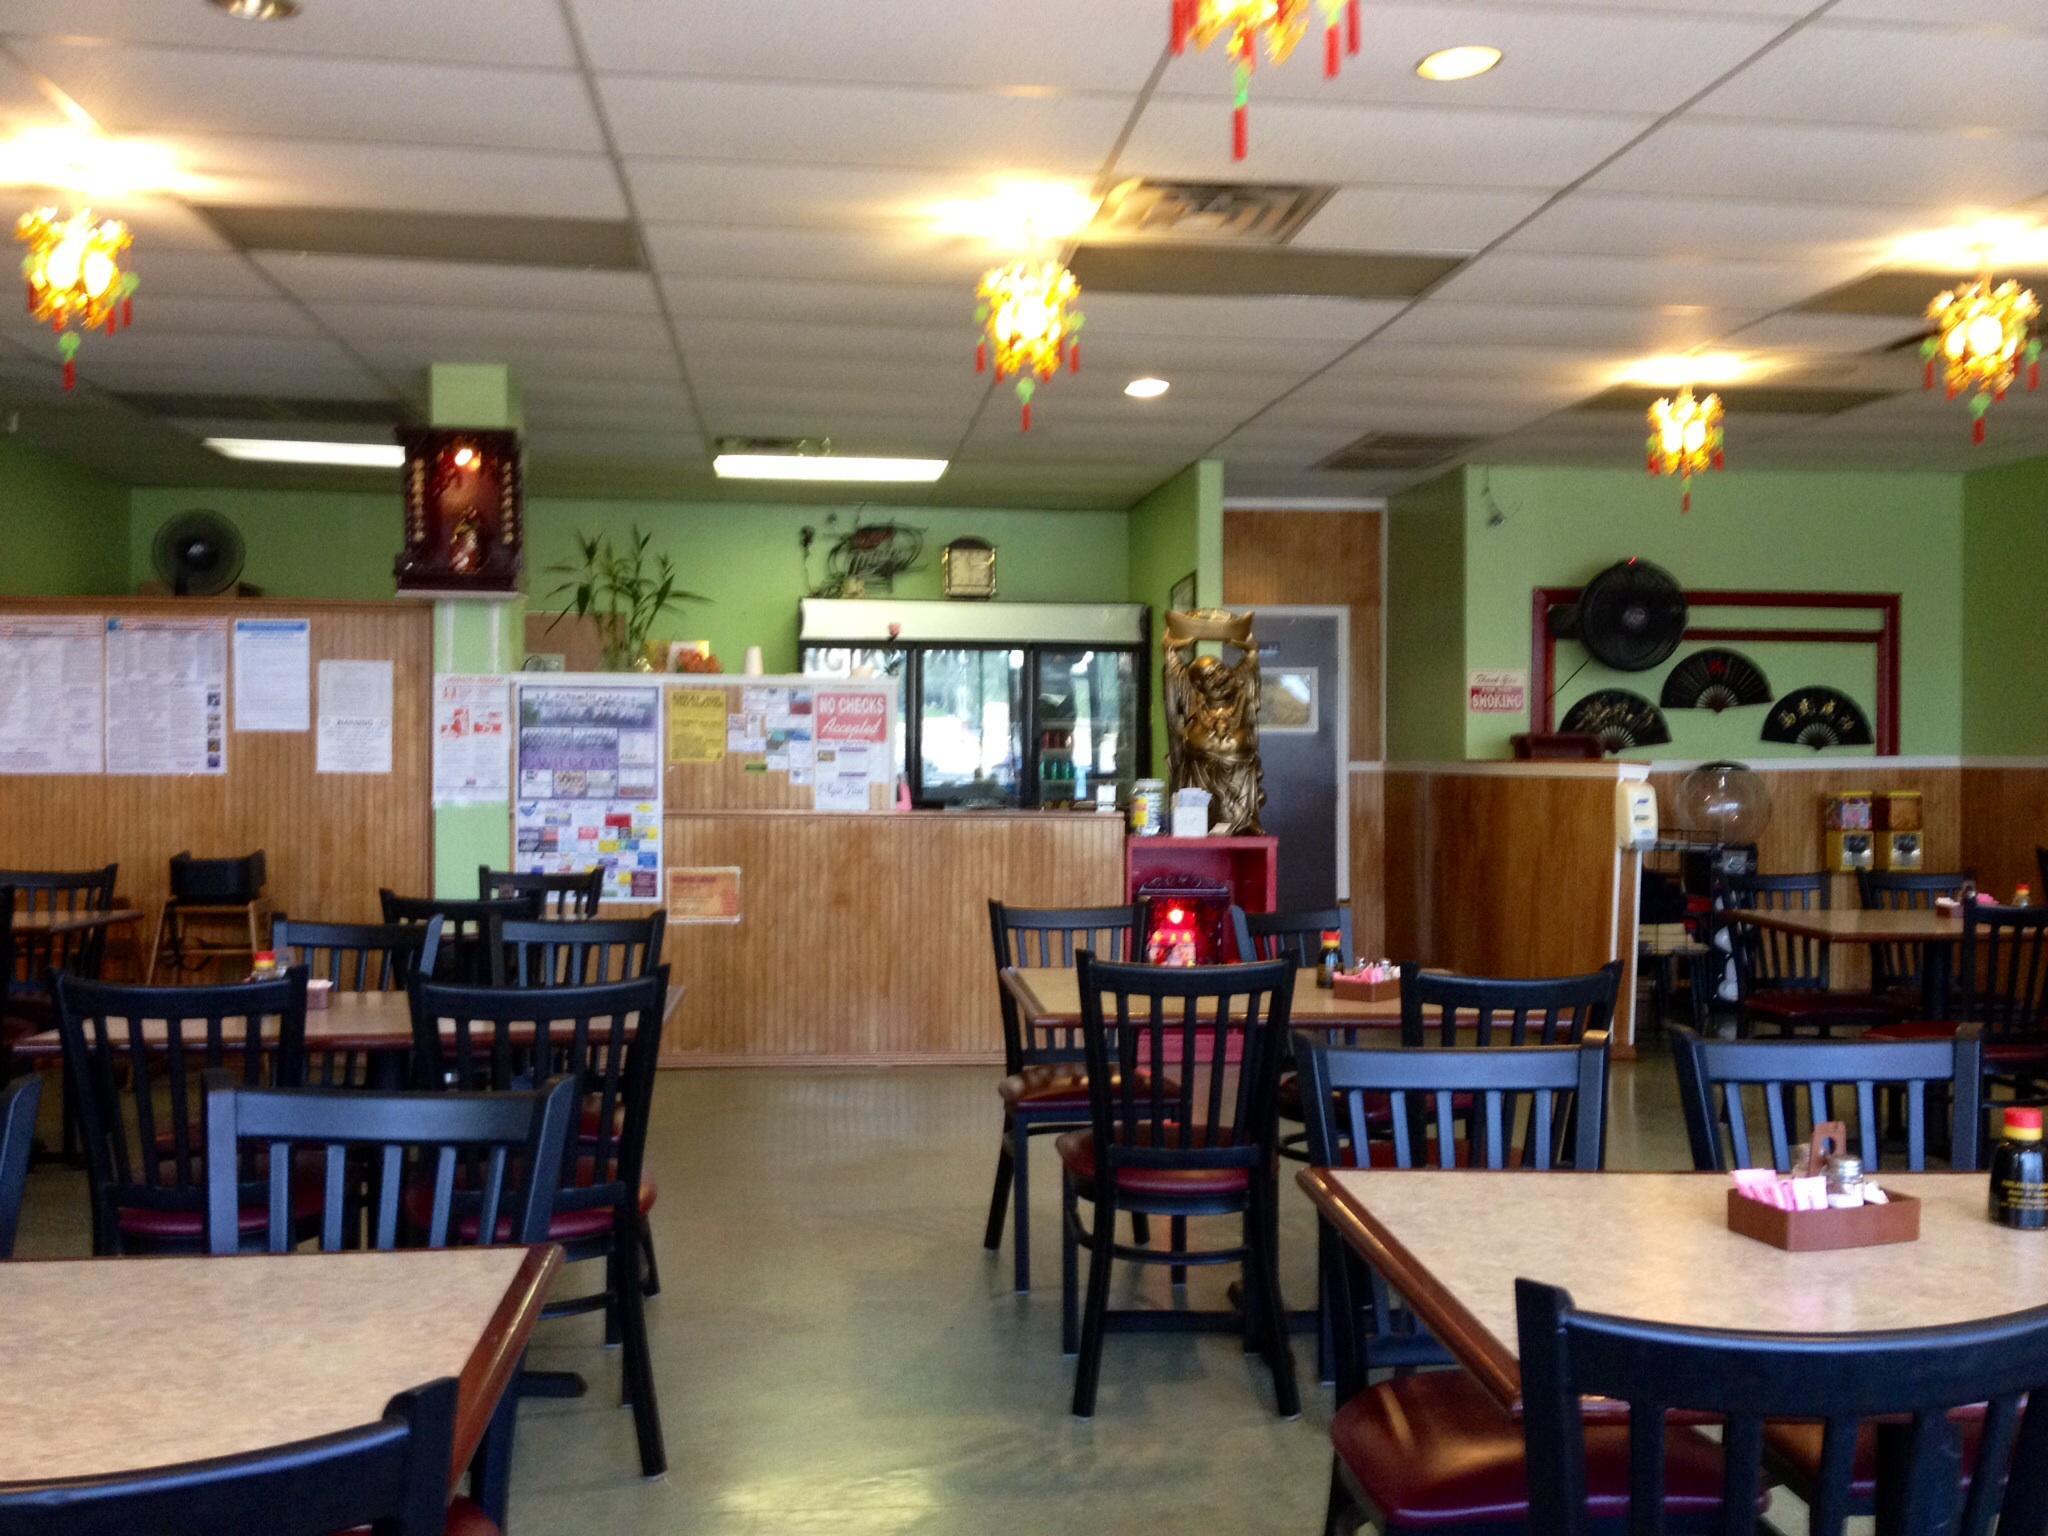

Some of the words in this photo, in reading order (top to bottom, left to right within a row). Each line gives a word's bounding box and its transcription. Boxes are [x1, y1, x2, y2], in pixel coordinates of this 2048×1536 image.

[819, 696, 836, 714] NO
[838, 696, 885, 714] CHECKS
[1472, 694, 1522, 708] SMOKING
[821, 716, 883, 739] Accepted
